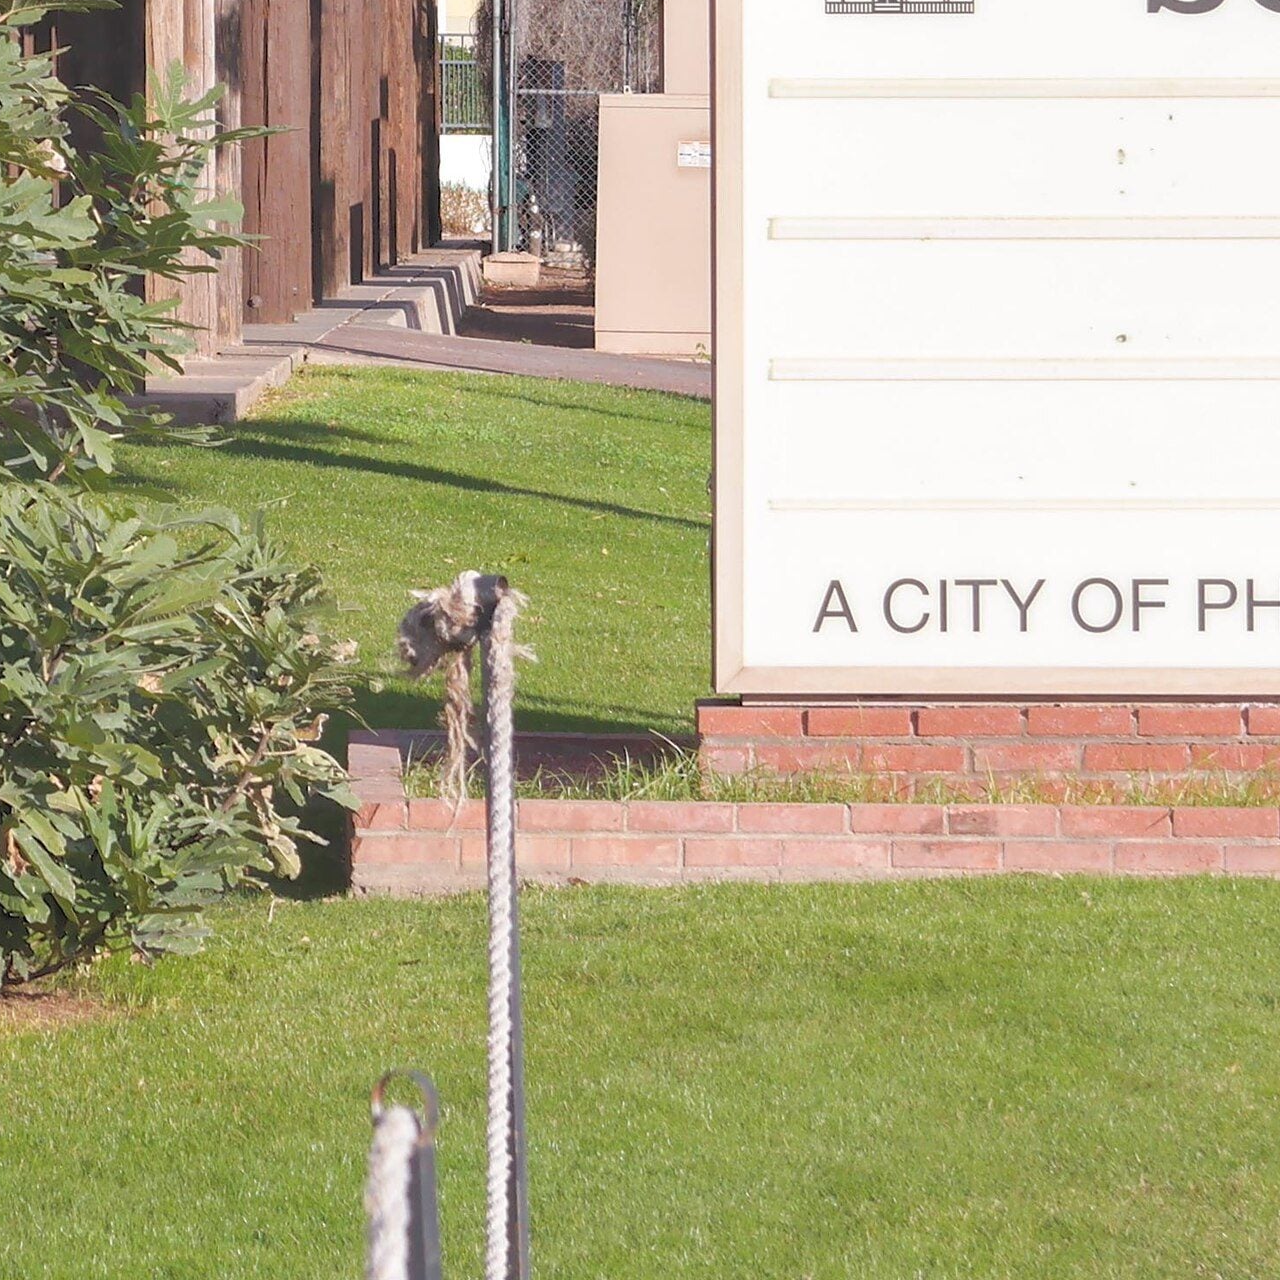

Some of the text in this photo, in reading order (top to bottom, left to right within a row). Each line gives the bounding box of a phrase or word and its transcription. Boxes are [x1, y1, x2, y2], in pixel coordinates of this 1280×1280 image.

[812, 579, 858, 632] A
[883, 577, 1045, 634] CITY
[1071, 576, 1169, 633] OF
